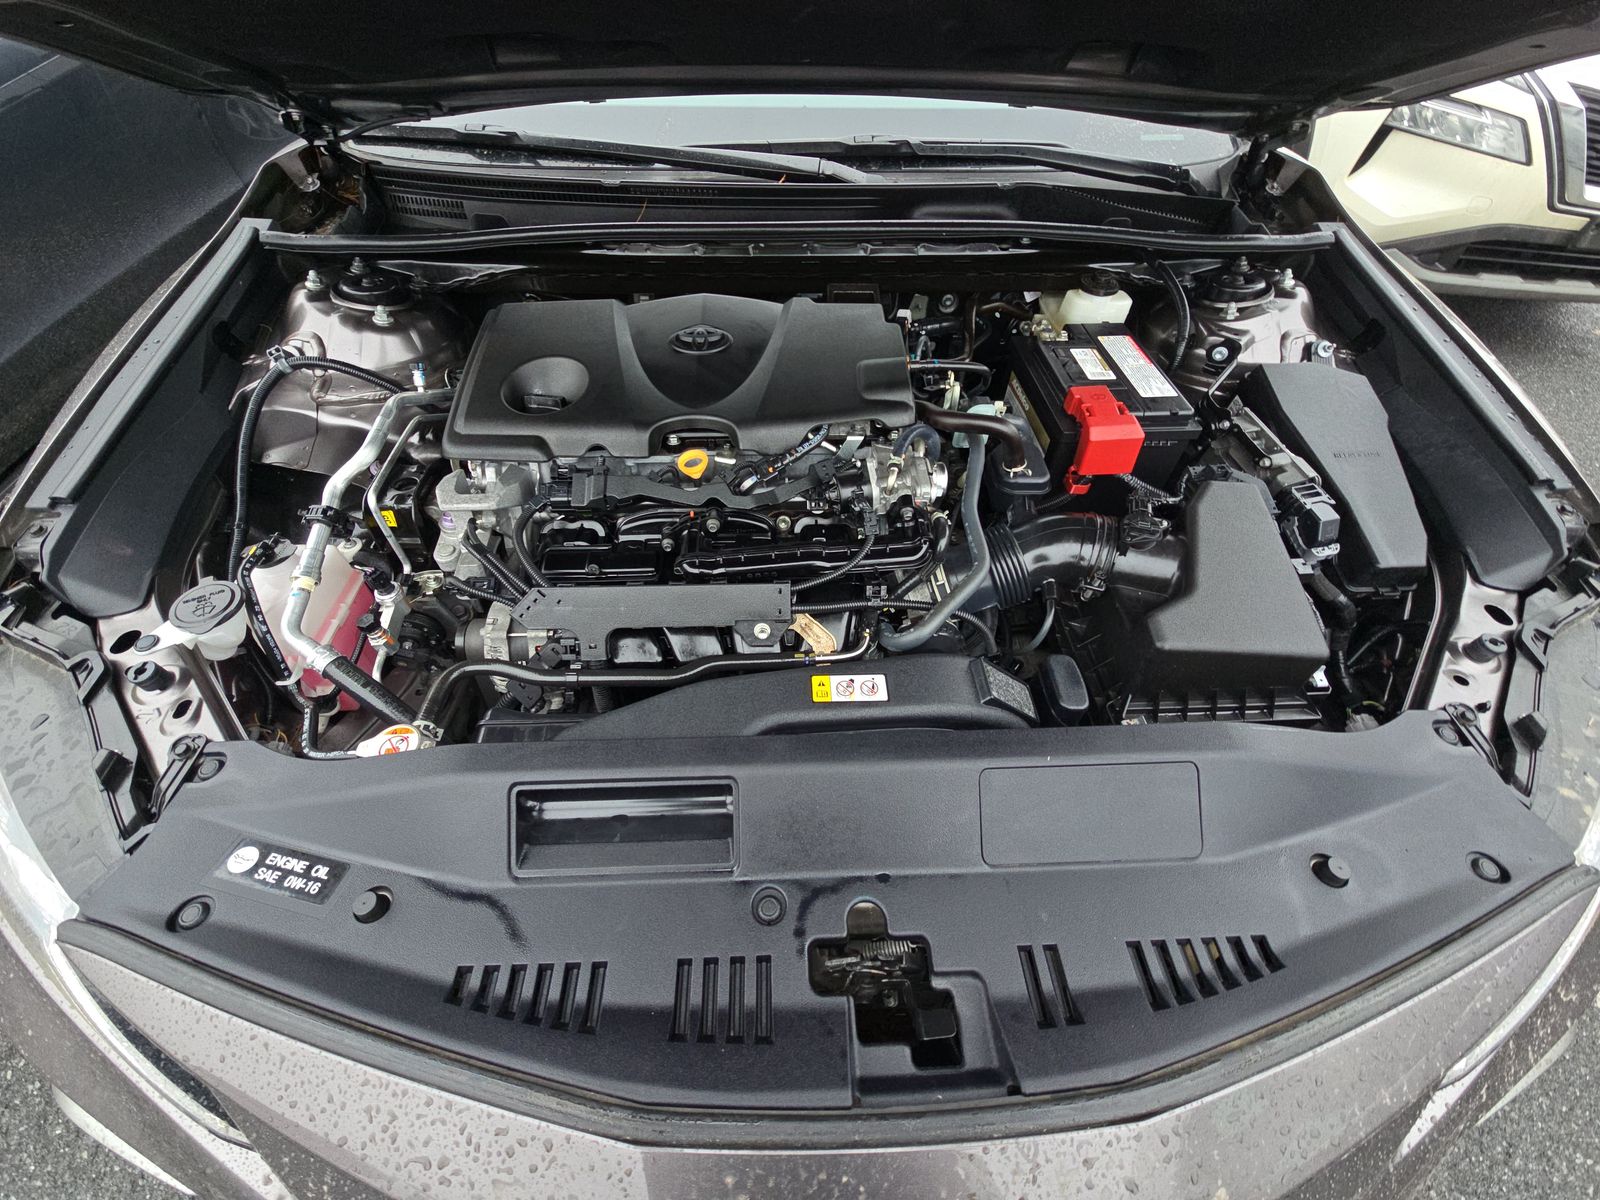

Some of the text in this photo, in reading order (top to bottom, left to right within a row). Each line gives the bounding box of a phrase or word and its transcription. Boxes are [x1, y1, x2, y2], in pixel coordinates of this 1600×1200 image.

[265, 852, 310, 874] ENGINE
[310, 864, 330, 880] OIL
[254, 867, 322, 895] SAE 0W-16
